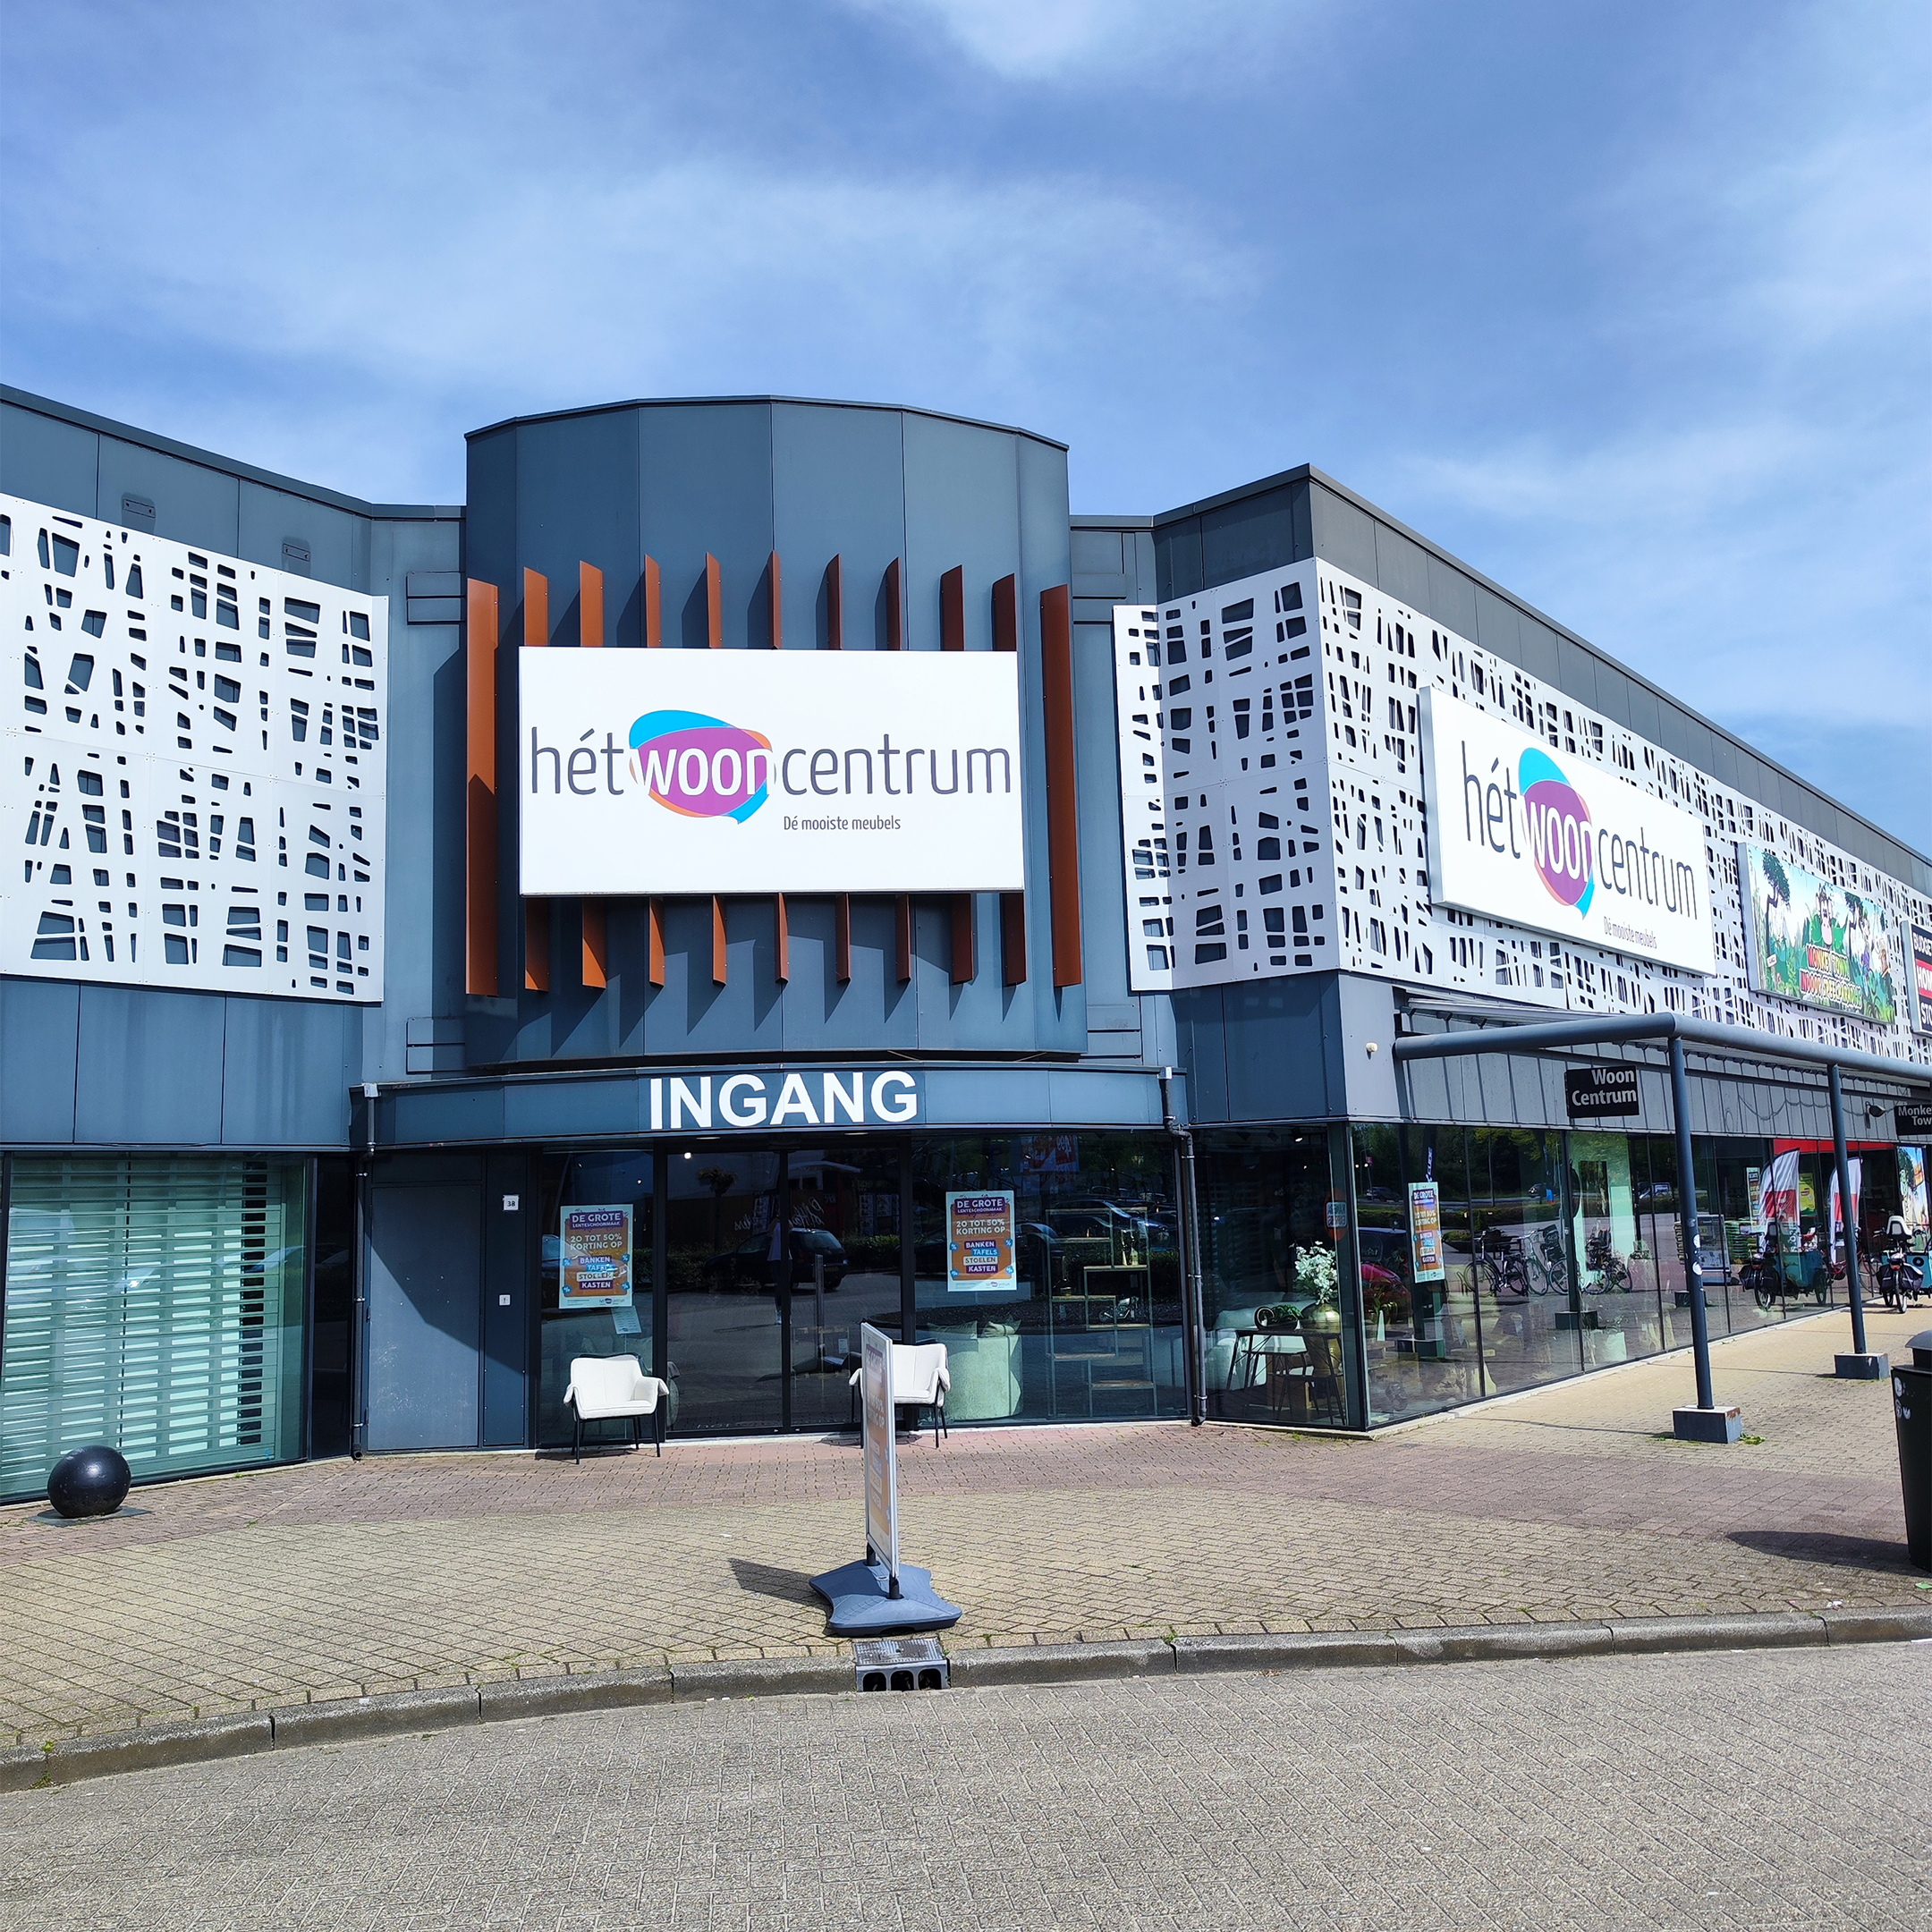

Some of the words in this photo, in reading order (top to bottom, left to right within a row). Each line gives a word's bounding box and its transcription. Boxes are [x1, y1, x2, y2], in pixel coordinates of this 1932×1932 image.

[784, 815, 798, 830] Dé
[801, 815, 849, 830] mooiste
[852, 815, 901, 830] meubels
[1591, 1068, 1635, 1085] Woon
[650, 1071, 918, 1130] INGANG
[1572, 1089, 1637, 1106] Centrum
[1898, 1105, 1932, 1116] Monke
[956, 1200, 970, 1208] DE
[971, 1199, 1003, 1208] GROTE
[572, 1215, 586, 1223] DE
[588, 1213, 621, 1222] GROTE
[956, 1227, 992, 1235] KORTING
[570, 1242, 607, 1250] KORTING
